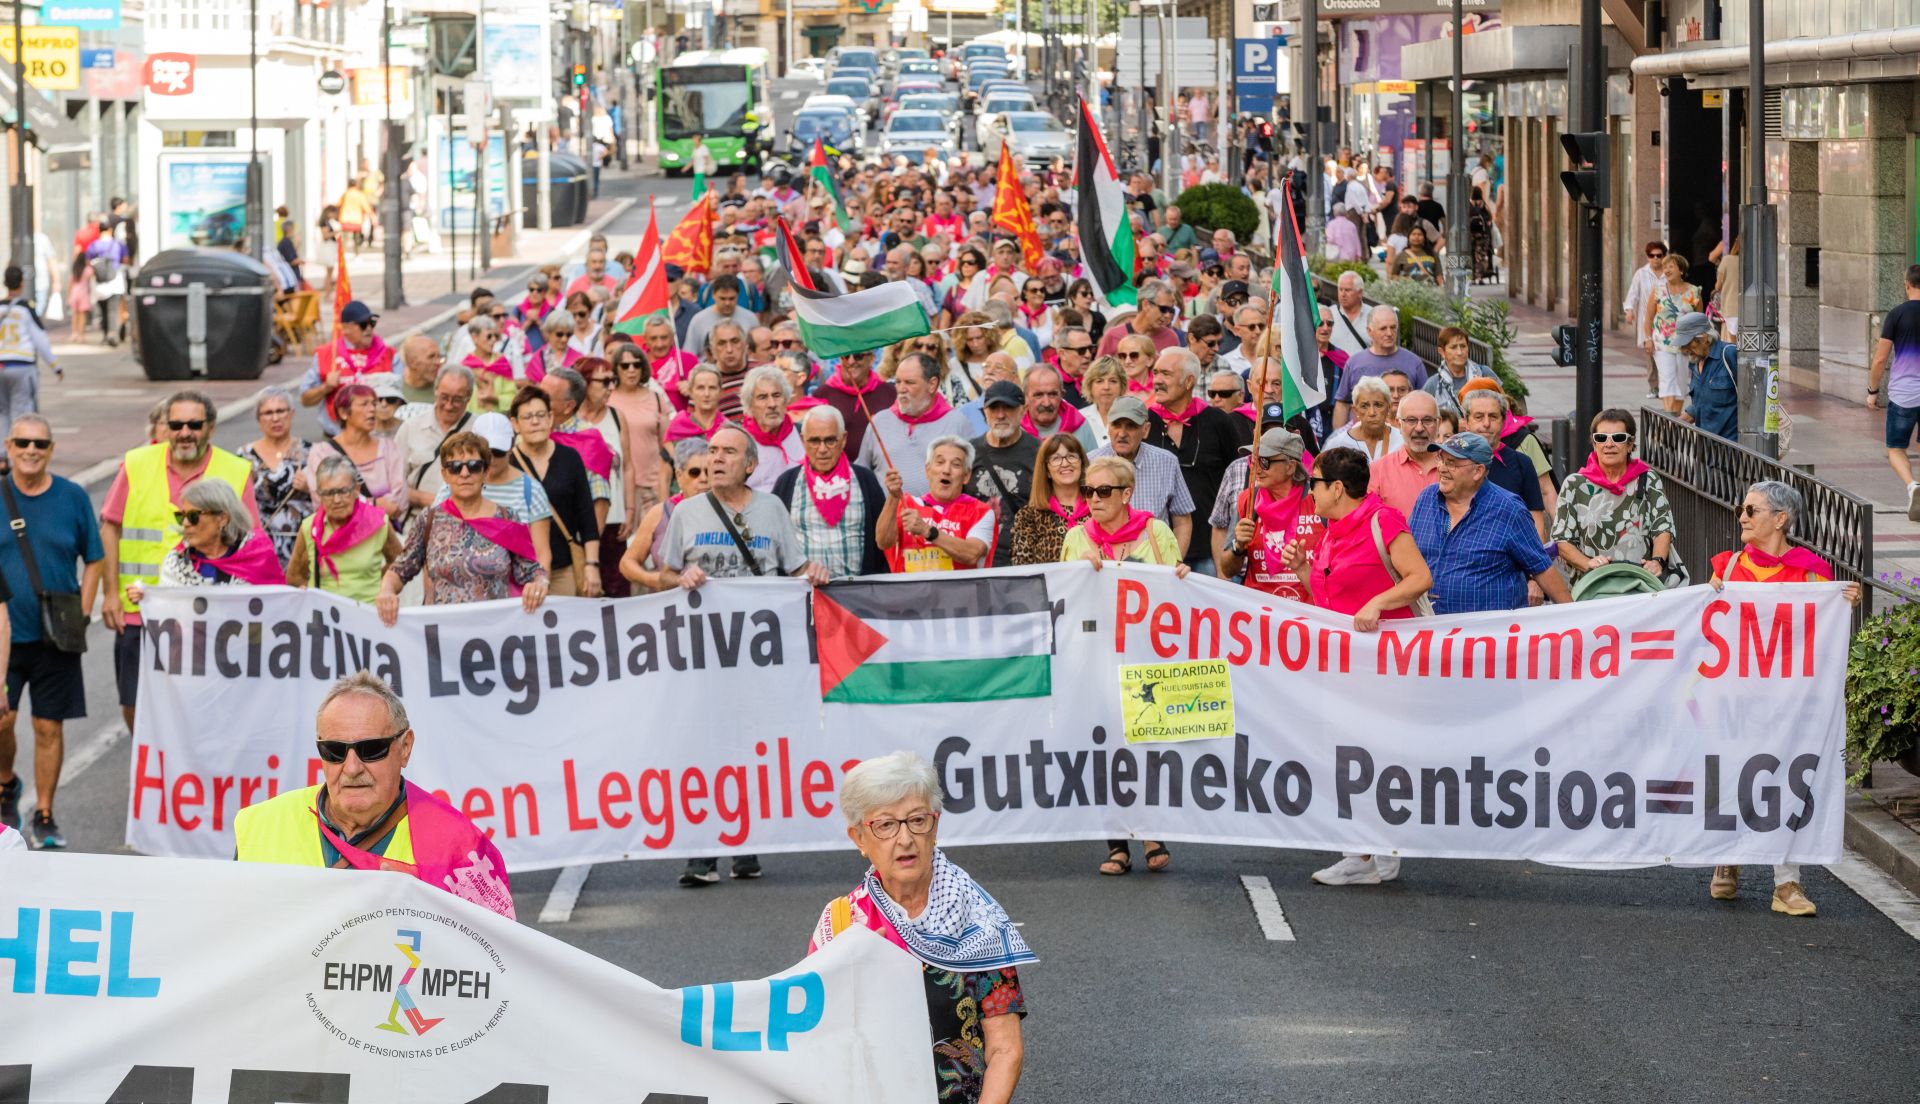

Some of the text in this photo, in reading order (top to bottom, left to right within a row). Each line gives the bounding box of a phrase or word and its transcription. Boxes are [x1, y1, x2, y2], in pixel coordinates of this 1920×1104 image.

[3, 37, 74, 49] CMPRO
[1244, 43, 1268, 72] P
[142, 596, 403, 698] niciativa
[425, 590, 784, 715] Legislativa
[1115, 579, 1351, 673] Pensión
[1698, 599, 1816, 680] SMI
[1126, 664, 1226, 680] EN SOLIDARIDAD
[1161, 680, 1227, 692] HUELGUISTAS DE
[1132, 722, 1228, 737] LOREZAINEKIN BAT
[133, 744, 279, 831] Herri
[563, 737, 862, 849] Legegile
[934, 725, 1312, 817] Gutxieneko
[311, 908, 506, 974] EUSKAL HERRIKO PENTSIODUNEN MUGIMENDUA
[323, 962, 491, 999] EHPM MPEH
[305, 992, 510, 1059] MOVIMIENTO DE PENSIONISTAS DE EUSKAL HERRIA
[680, 971, 825, 1051] ILP
